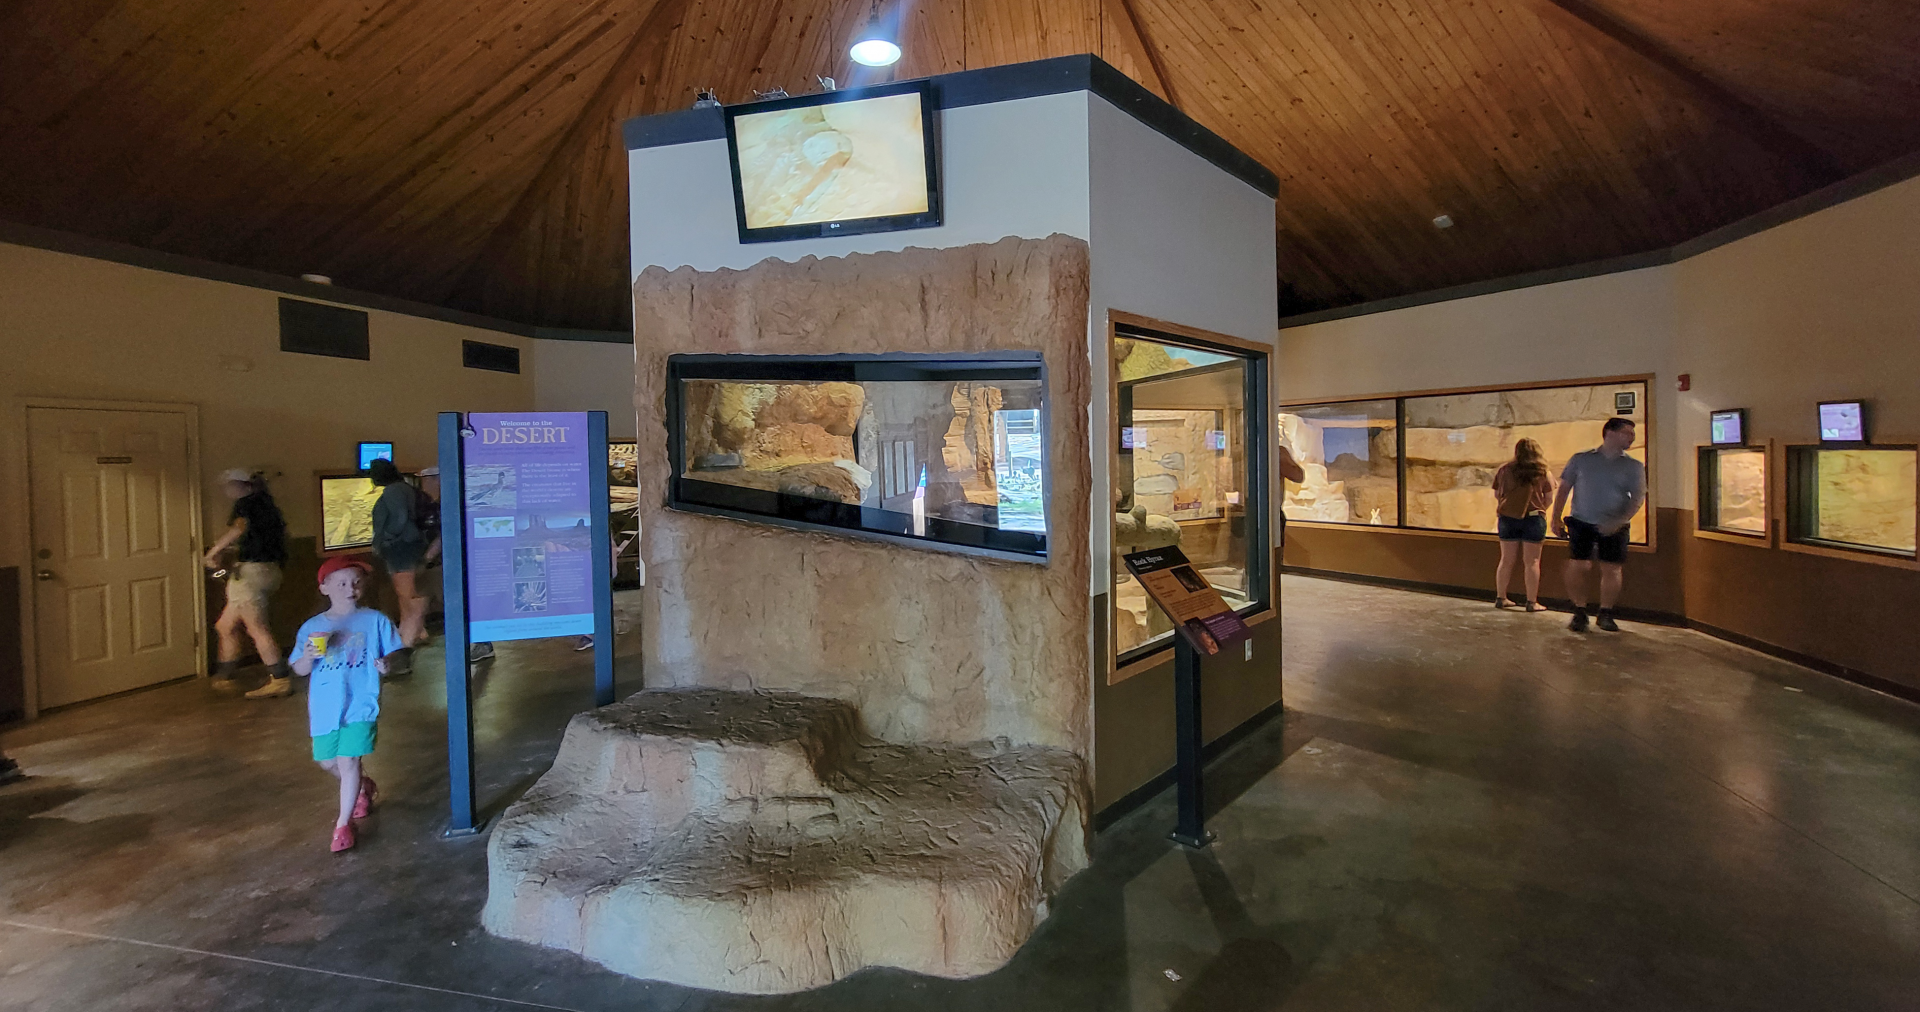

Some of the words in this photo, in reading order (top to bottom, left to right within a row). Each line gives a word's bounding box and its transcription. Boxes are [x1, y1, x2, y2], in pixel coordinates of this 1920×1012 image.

[482, 427, 570, 445] DESERT
[1132, 557, 1148, 566] Rock
[1145, 555, 1164, 564] Hyrax
